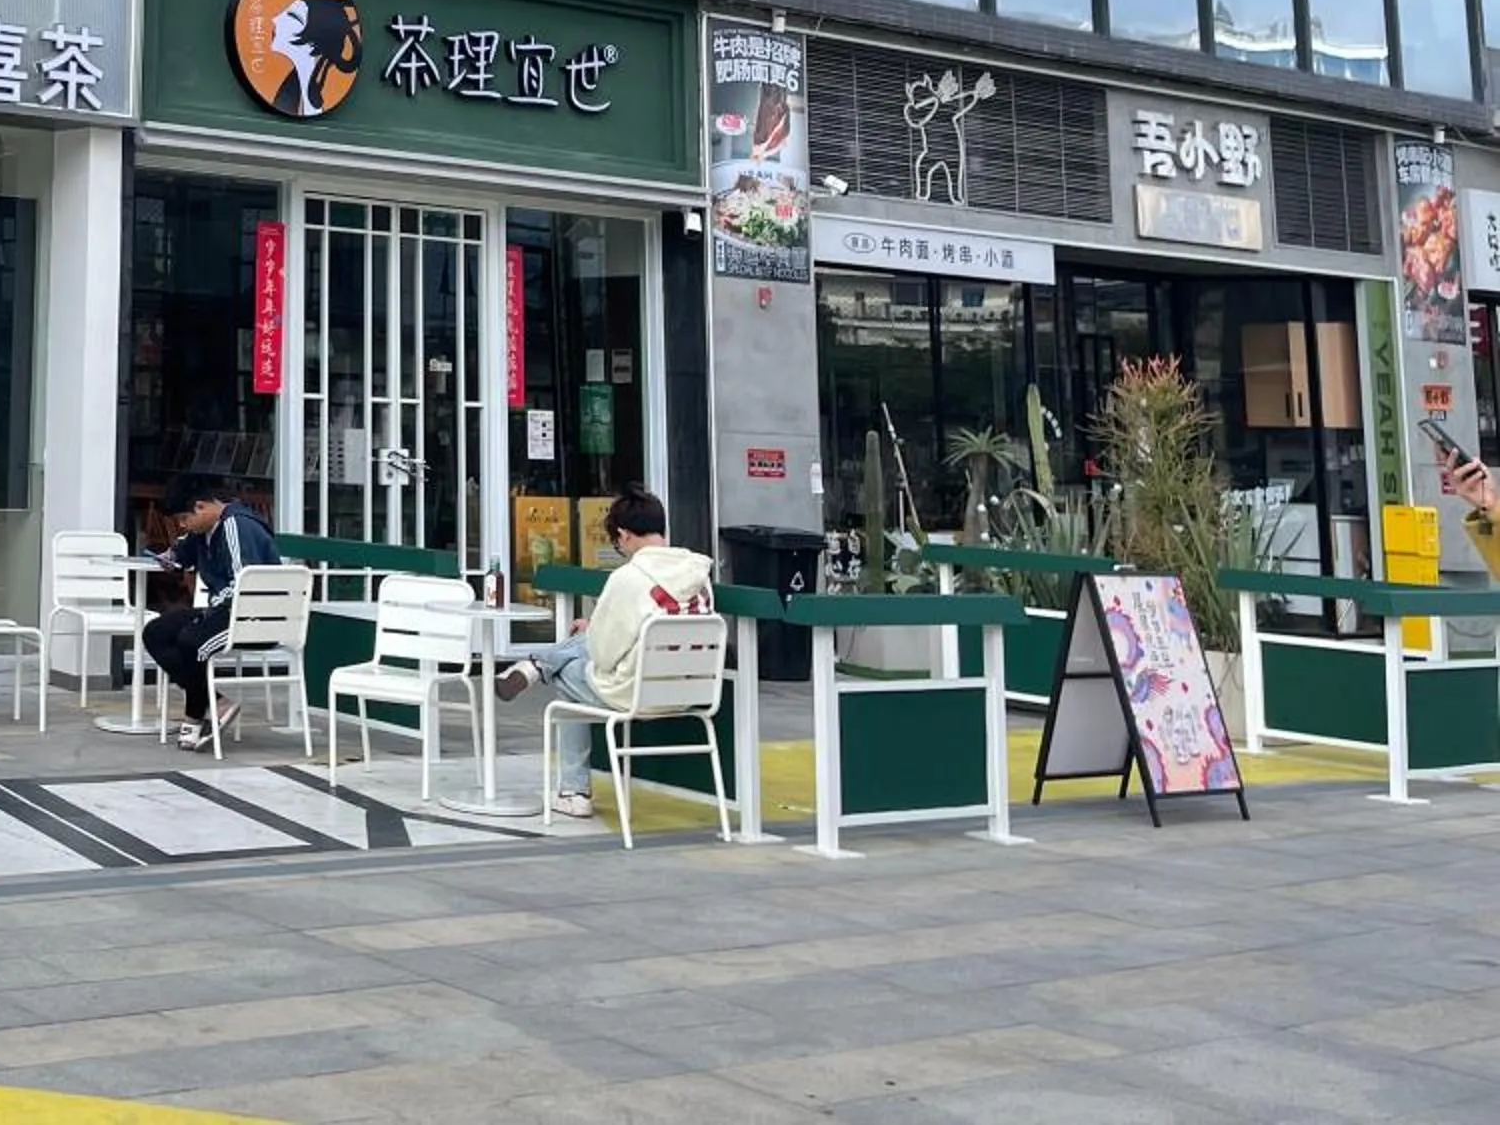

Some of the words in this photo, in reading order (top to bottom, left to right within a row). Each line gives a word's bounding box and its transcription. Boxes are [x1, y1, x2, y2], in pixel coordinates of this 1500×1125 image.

[1133, 109, 1263, 187] 吾小野
[1374, 342, 1395, 456] YEAH
